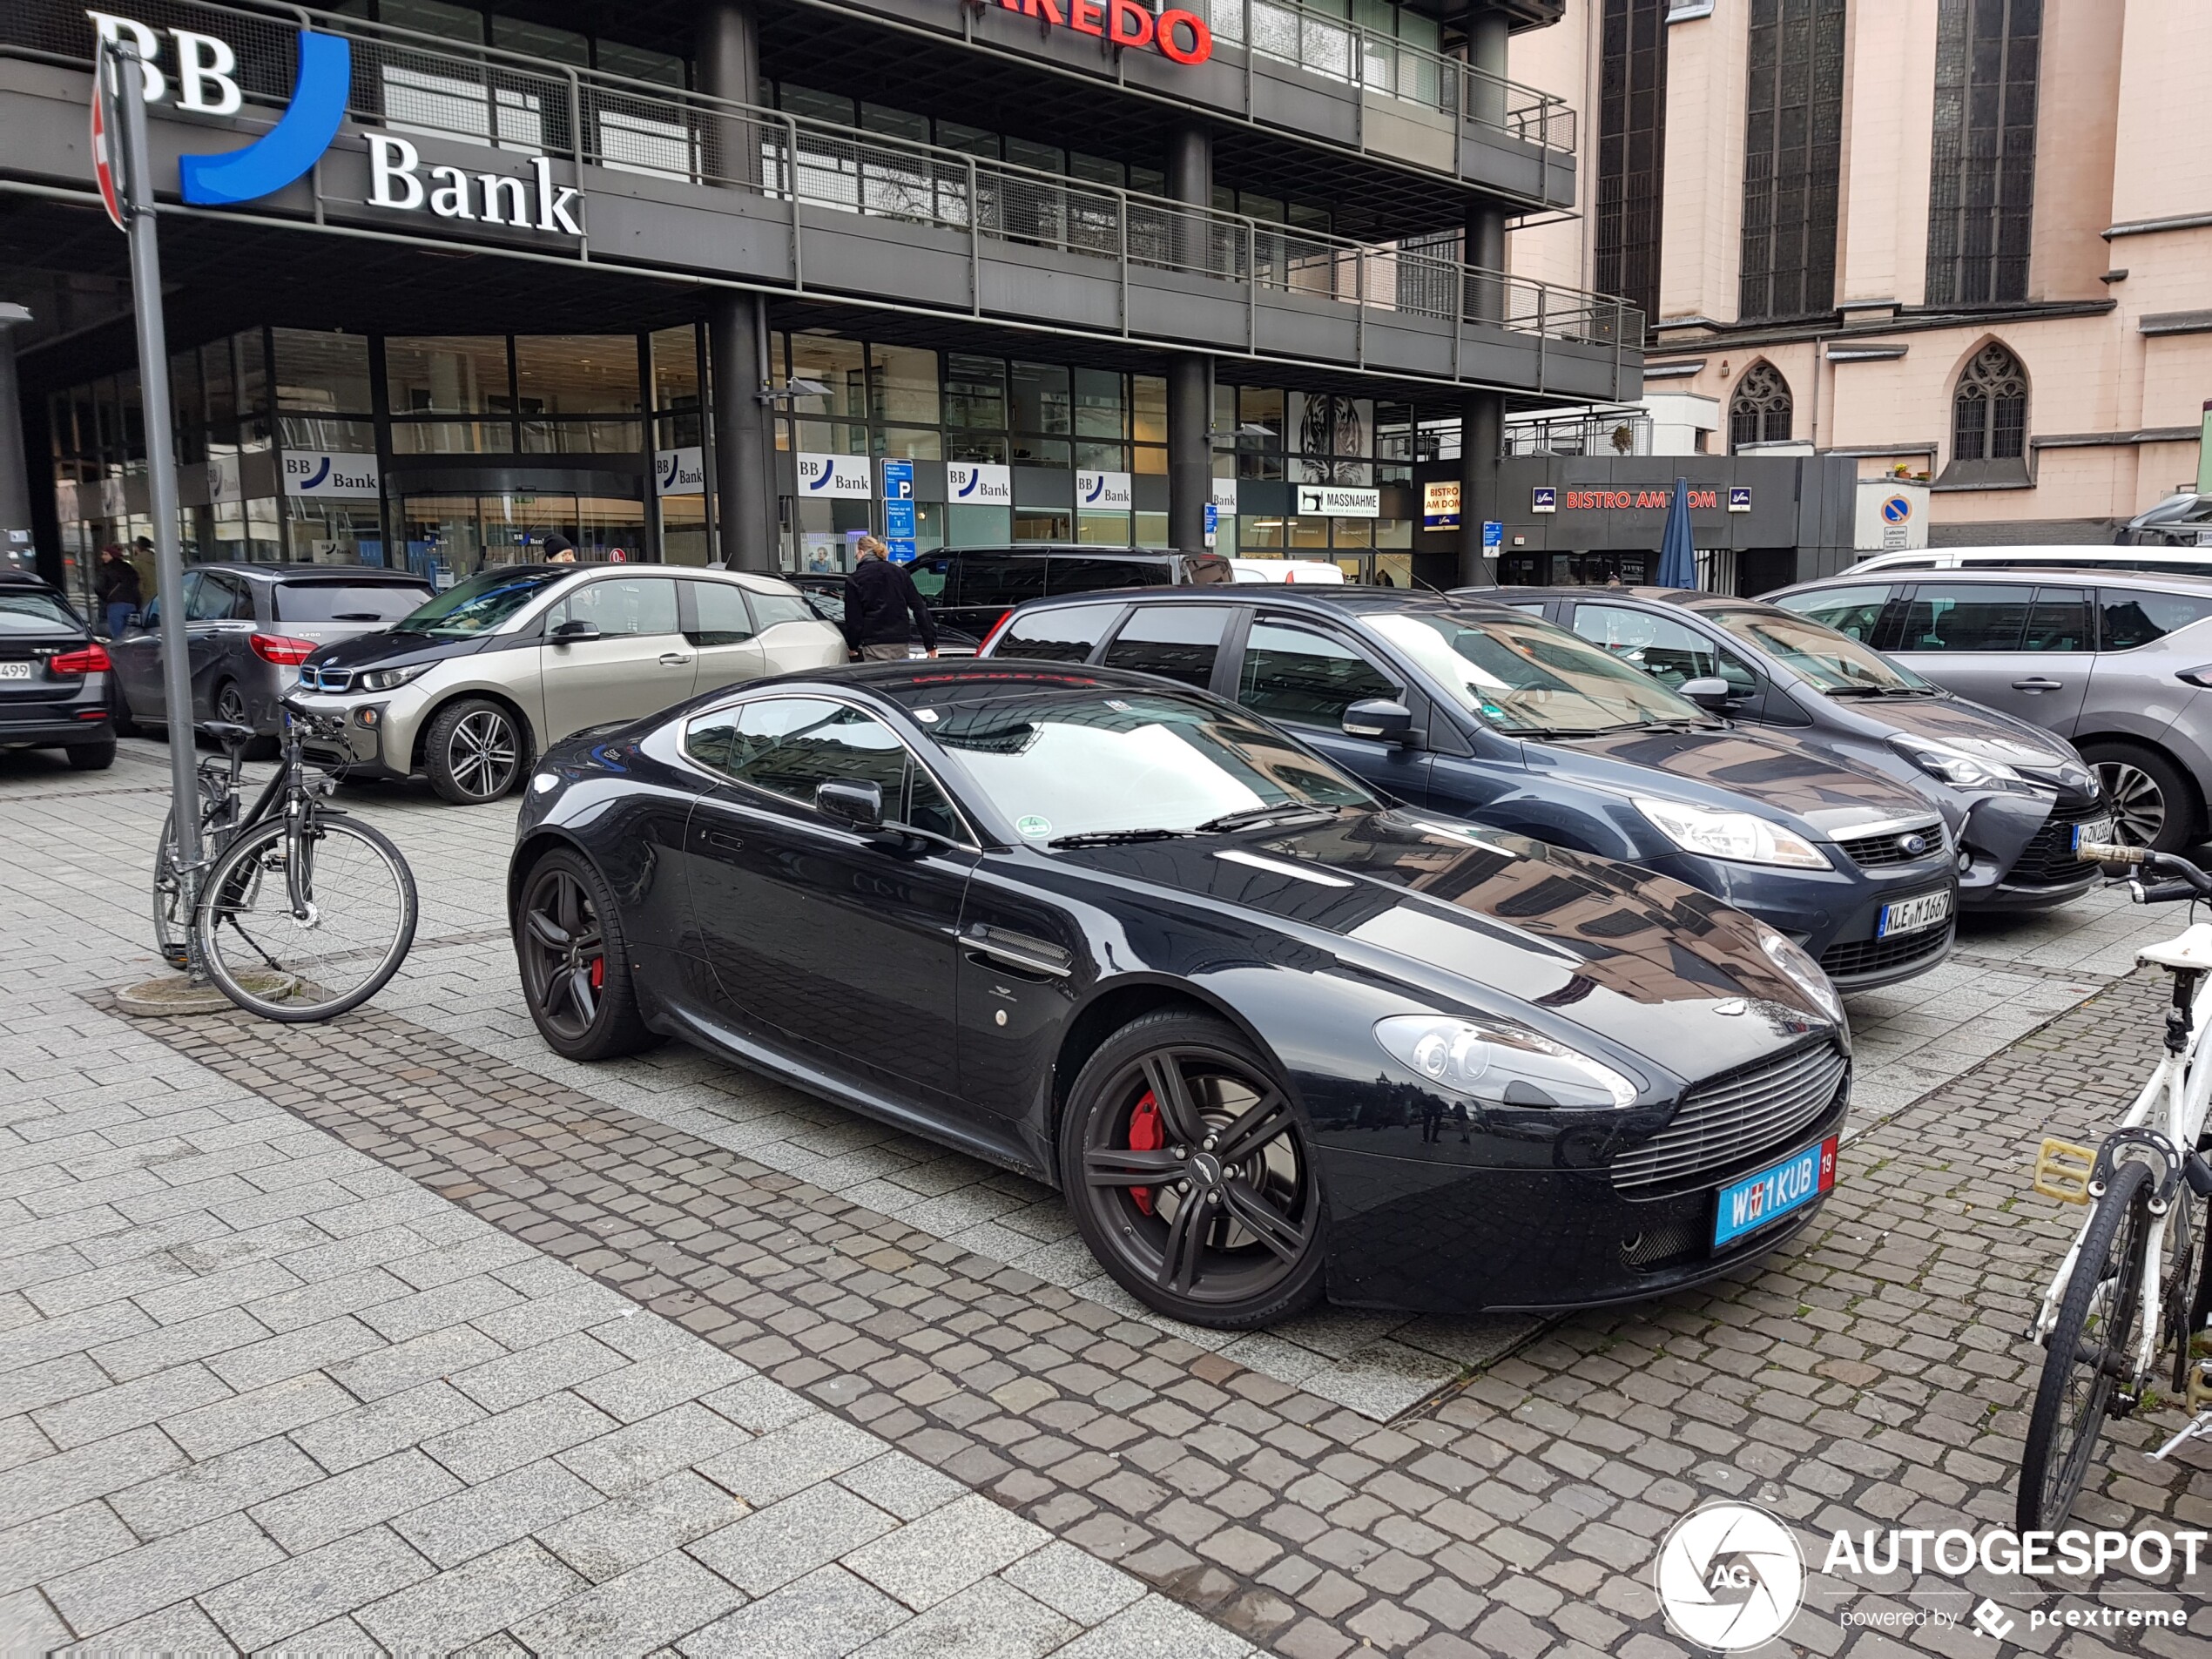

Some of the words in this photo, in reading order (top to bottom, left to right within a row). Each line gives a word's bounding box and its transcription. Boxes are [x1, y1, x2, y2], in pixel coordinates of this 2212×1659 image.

[997, 0, 1212, 65] EDO
[85, 9, 242, 115] BB
[362, 132, 583, 236] Bank
[285, 459, 311, 475] BB
[333, 473, 377, 489] Bank
[656, 459, 670, 475] BB
[679, 467, 703, 485] Bank
[799, 462, 819, 475] BB
[835, 475, 869, 490] Bank
[949, 470, 966, 484] BB
[980, 482, 1009, 496] Bank
[900, 481, 911, 500] P
[1078, 478, 1093, 490] BB
[1104, 489, 1130, 502] Bank
[1213, 494, 1236, 507] Bank
[1326, 493, 1378, 509] MASSNAHME
[1430, 487, 1459, 497] BISTRO
[1566, 490, 1632, 509] BISTRO
[1635, 490, 1667, 509] AM
[1671, 490, 1717, 509] OM
[1426, 499, 1440, 509] AM
[1441, 498, 1460, 509] DOM
[2, 664, 29, 677] 499
[1886, 903, 1910, 933] KLE
[1732, 1187, 1750, 1228] W
[1821, 1153, 1833, 1175] 19
